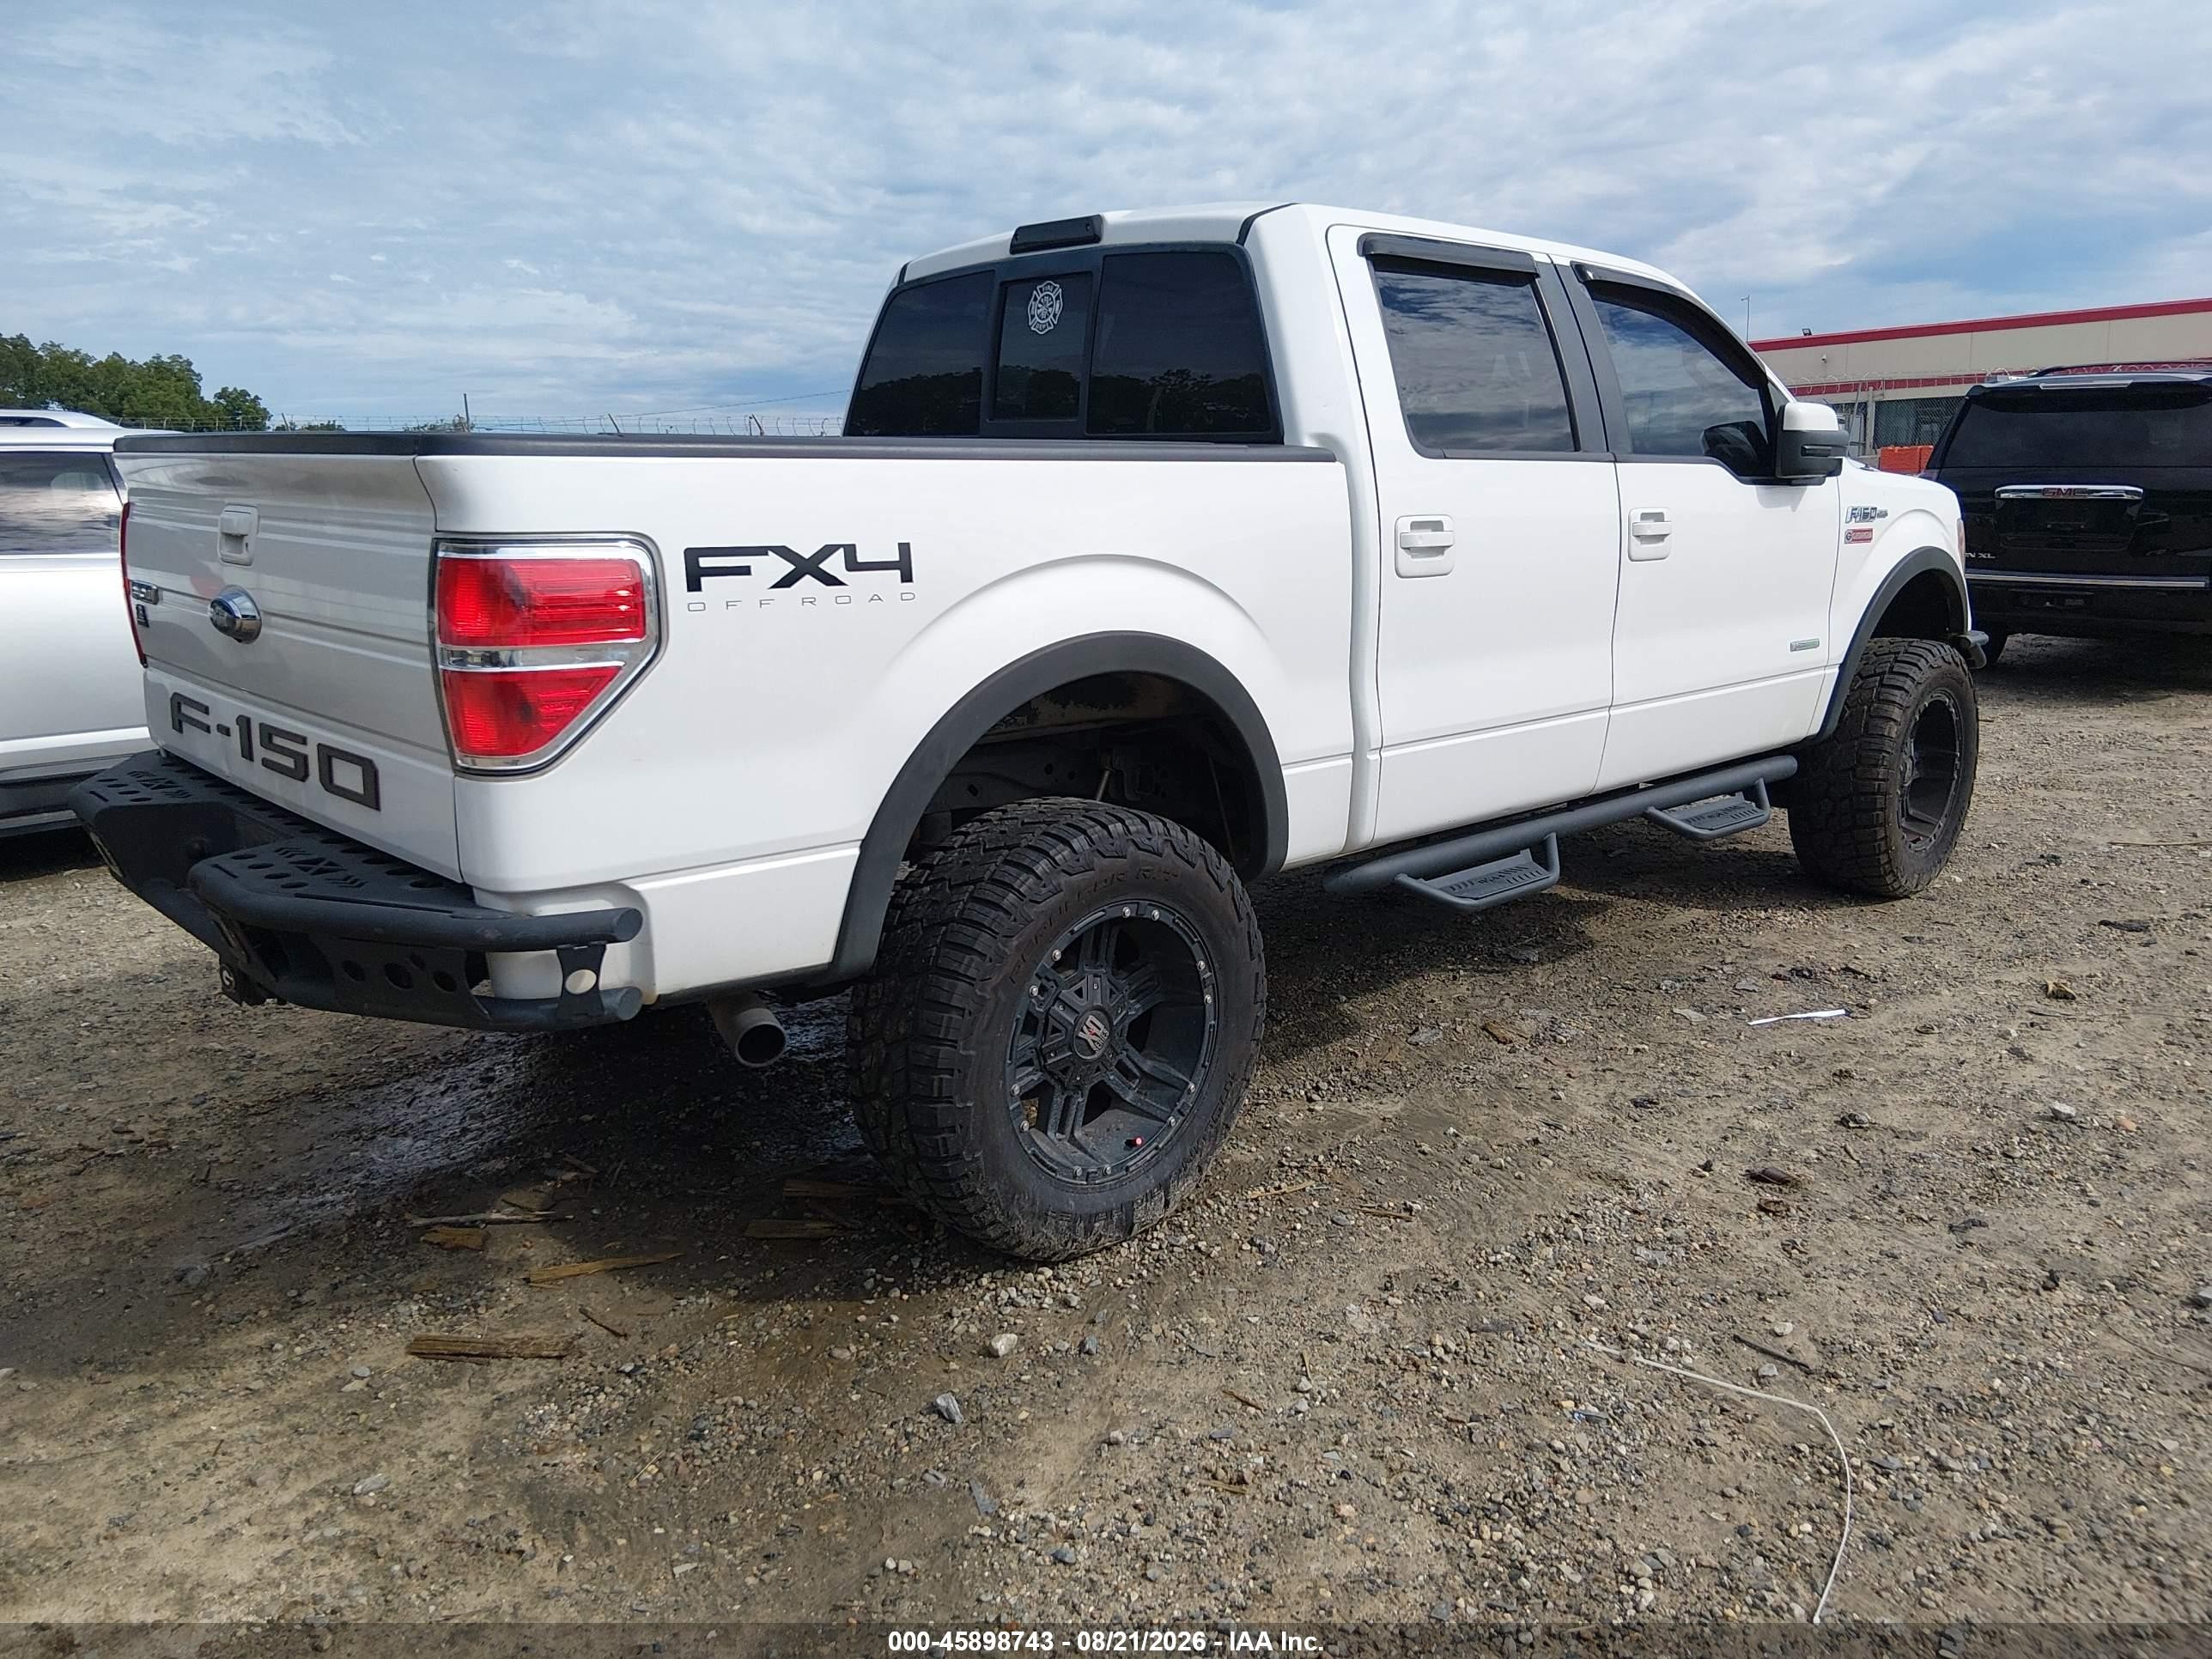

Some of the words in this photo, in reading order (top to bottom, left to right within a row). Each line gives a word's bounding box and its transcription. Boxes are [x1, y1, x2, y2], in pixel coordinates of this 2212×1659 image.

[1042, 284, 1054, 293] FIRE
[2042, 487, 2089, 497] GMC
[684, 542, 914, 592] FX4
[171, 691, 381, 812] F-150
